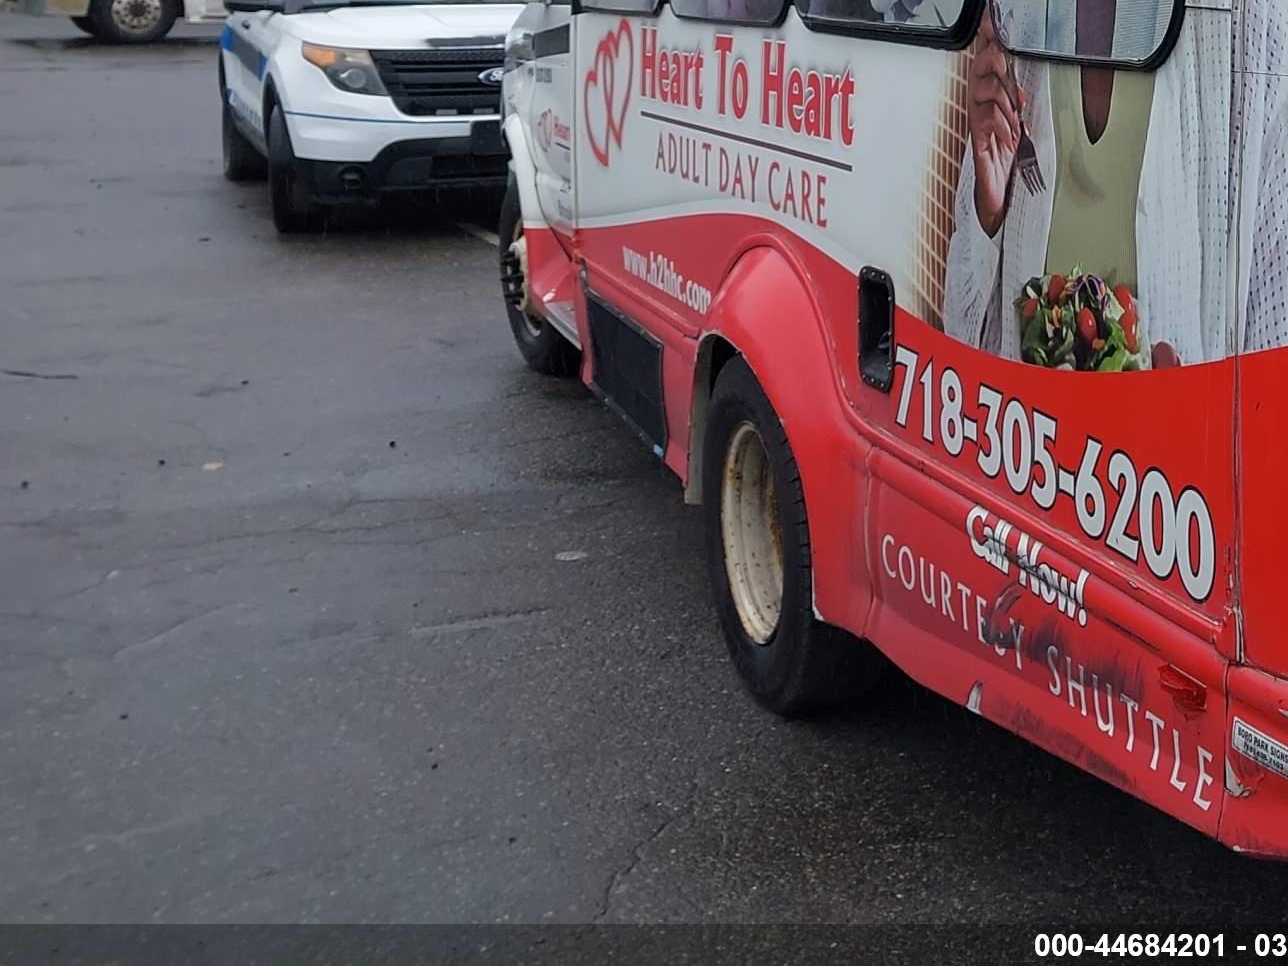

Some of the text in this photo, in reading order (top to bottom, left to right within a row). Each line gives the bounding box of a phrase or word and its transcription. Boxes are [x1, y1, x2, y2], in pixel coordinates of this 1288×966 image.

[639, 25, 856, 148] Heart To Heart
[655, 130, 828, 229] ADULT DAY CARE
[622, 245, 712, 315] www.h2hhc.com
[893, 345, 1216, 602] 718-305-6200
[966, 503, 1091, 627] Call Now!
[1047, 643, 1213, 812] SHUTTLE
